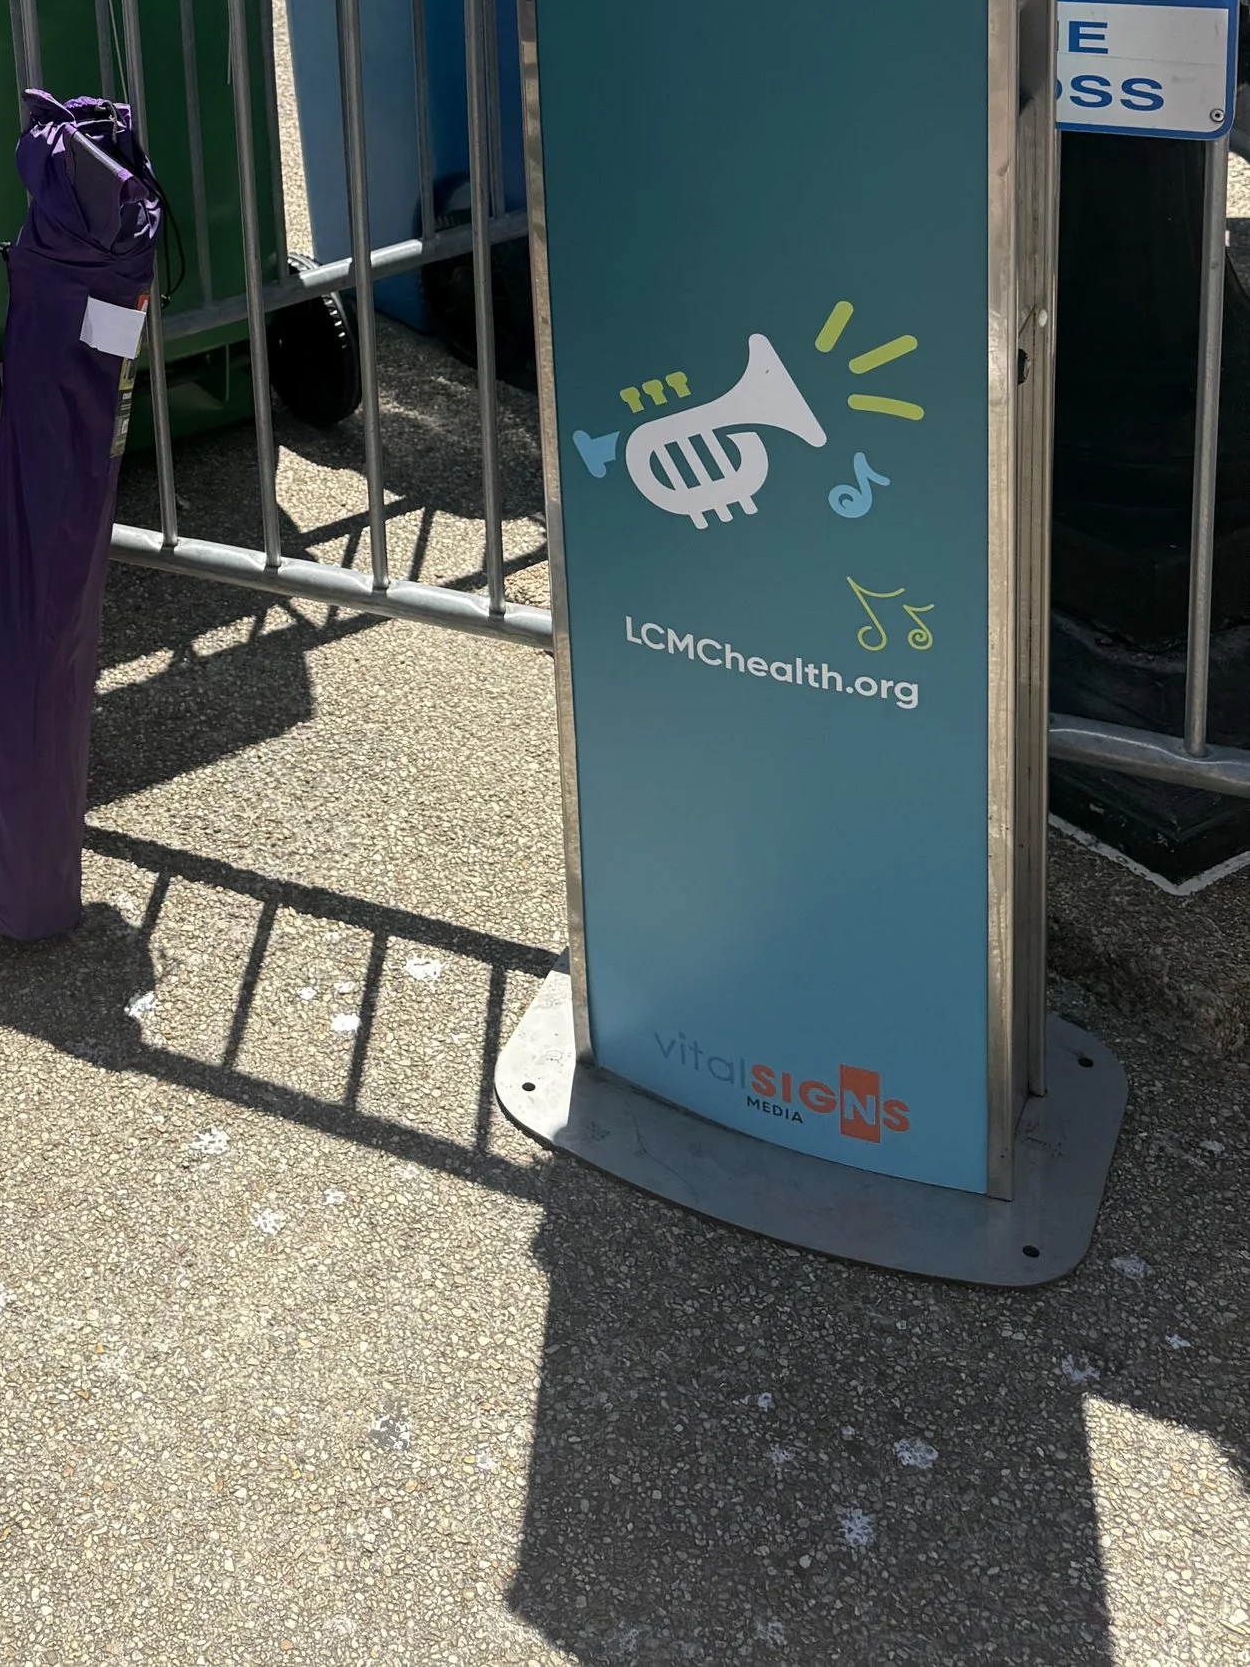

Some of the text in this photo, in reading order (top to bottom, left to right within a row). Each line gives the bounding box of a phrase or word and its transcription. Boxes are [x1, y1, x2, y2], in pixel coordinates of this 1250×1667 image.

[1058, 20, 1108, 54] E
[625, 615, 919, 710] LCMChealth.org
[746, 1096, 804, 1124] MEDIA
